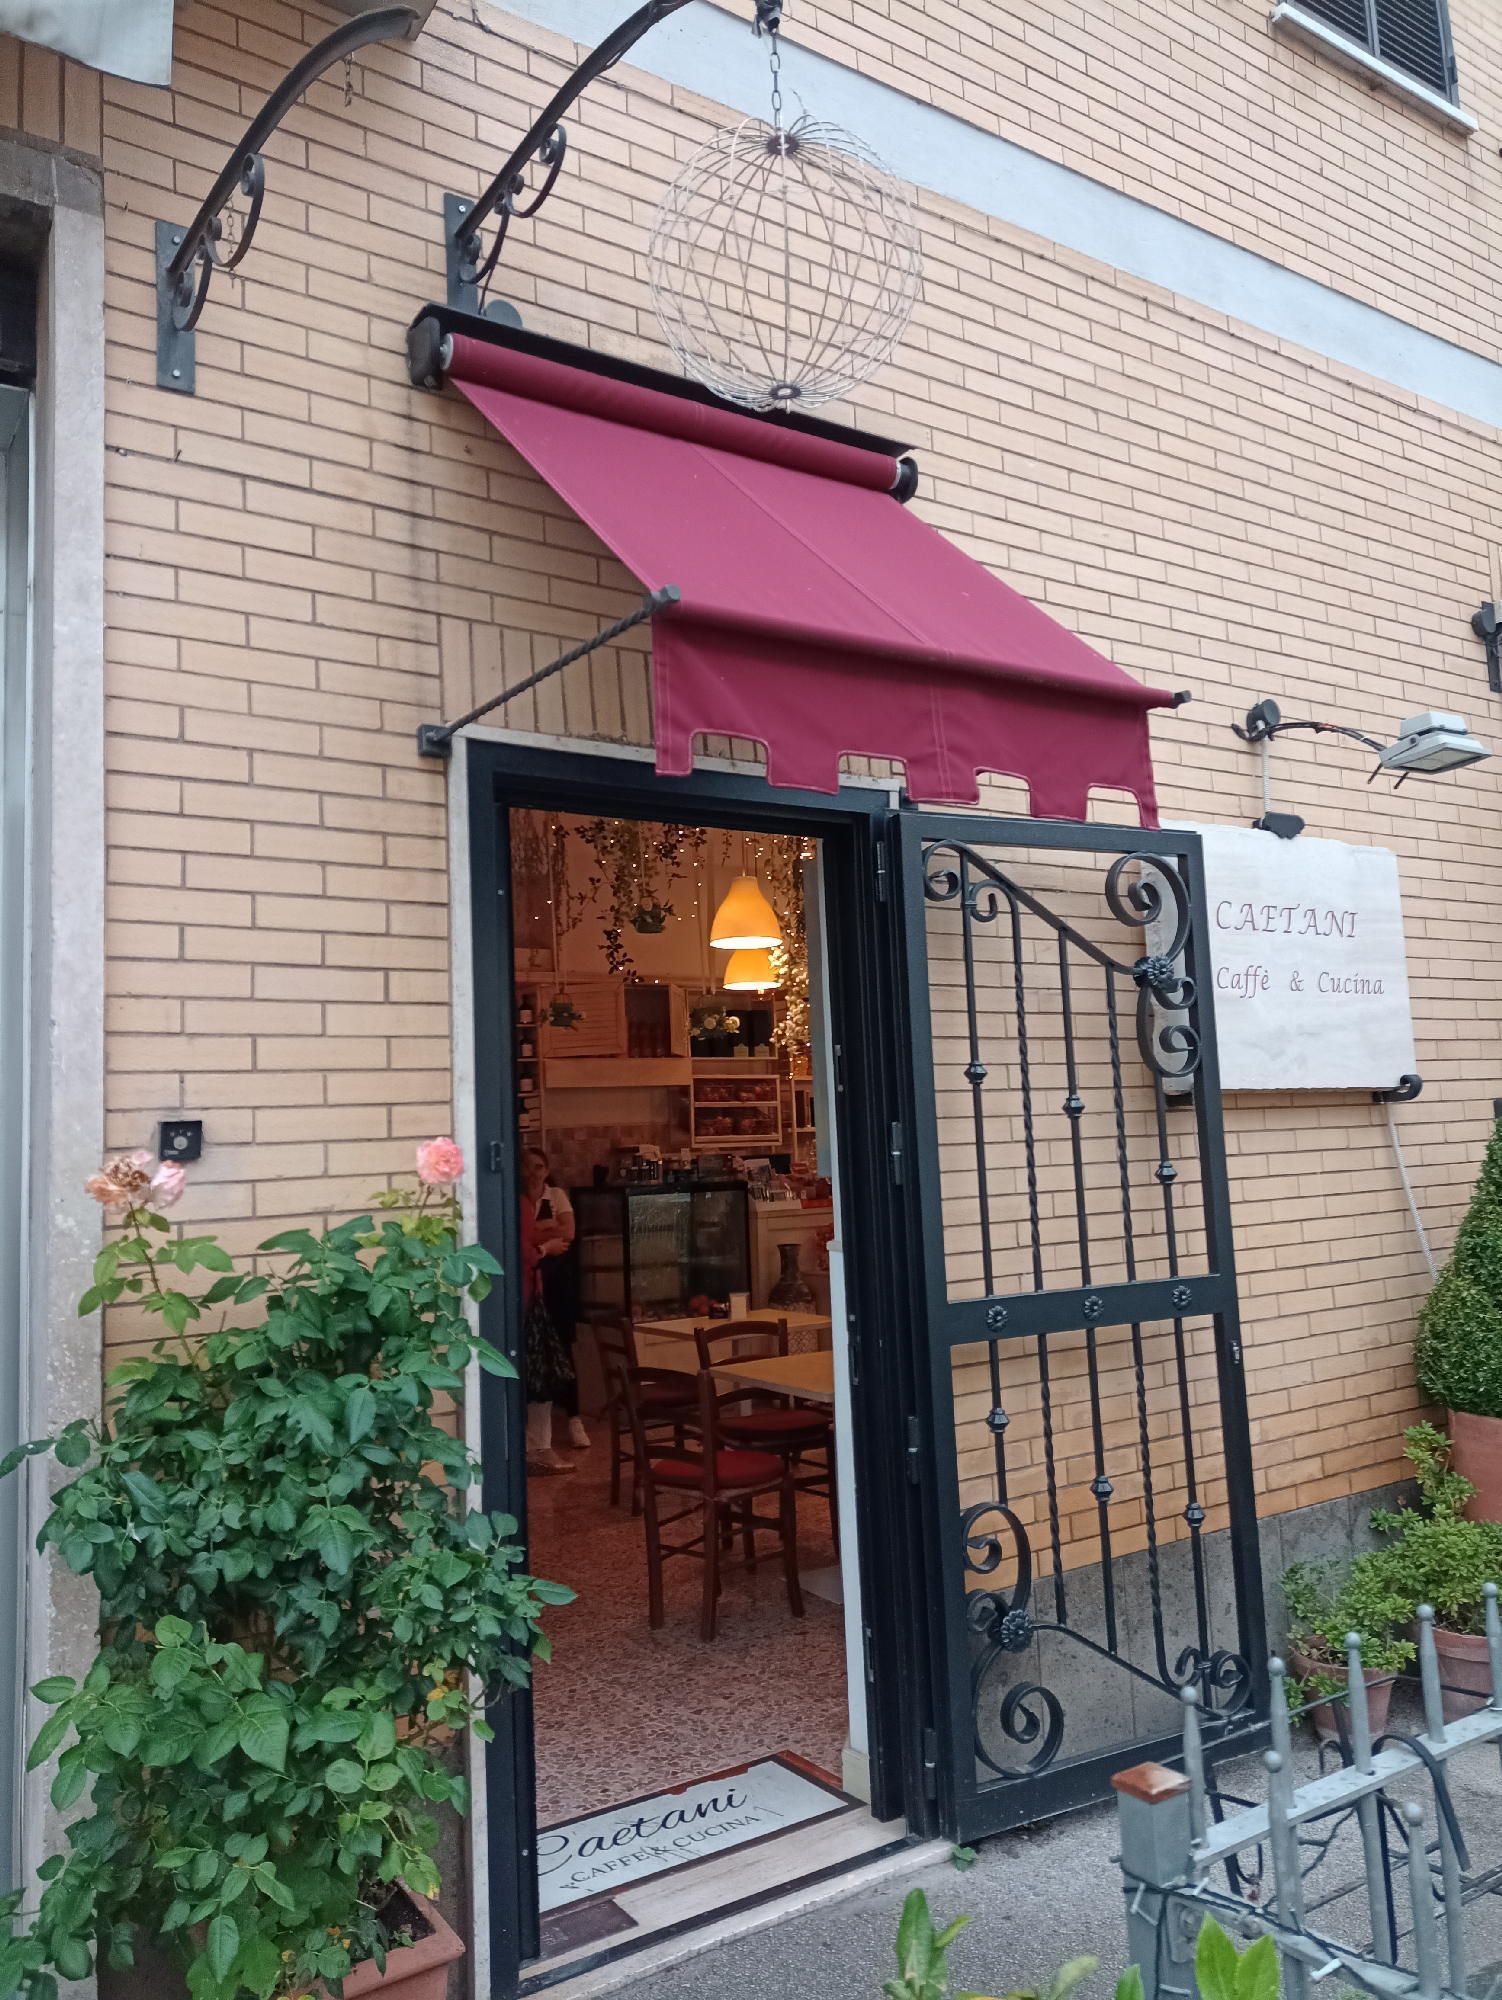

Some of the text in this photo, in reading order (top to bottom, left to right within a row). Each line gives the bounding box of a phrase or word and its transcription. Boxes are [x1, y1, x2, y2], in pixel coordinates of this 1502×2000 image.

[1216, 901, 1357, 937] CAETANI
[1290, 970, 1304, 991] &
[1318, 971, 1385, 995] Cucina
[536, 1788, 747, 1876] Caetani
[672, 1815, 762, 1848] CUCINA
